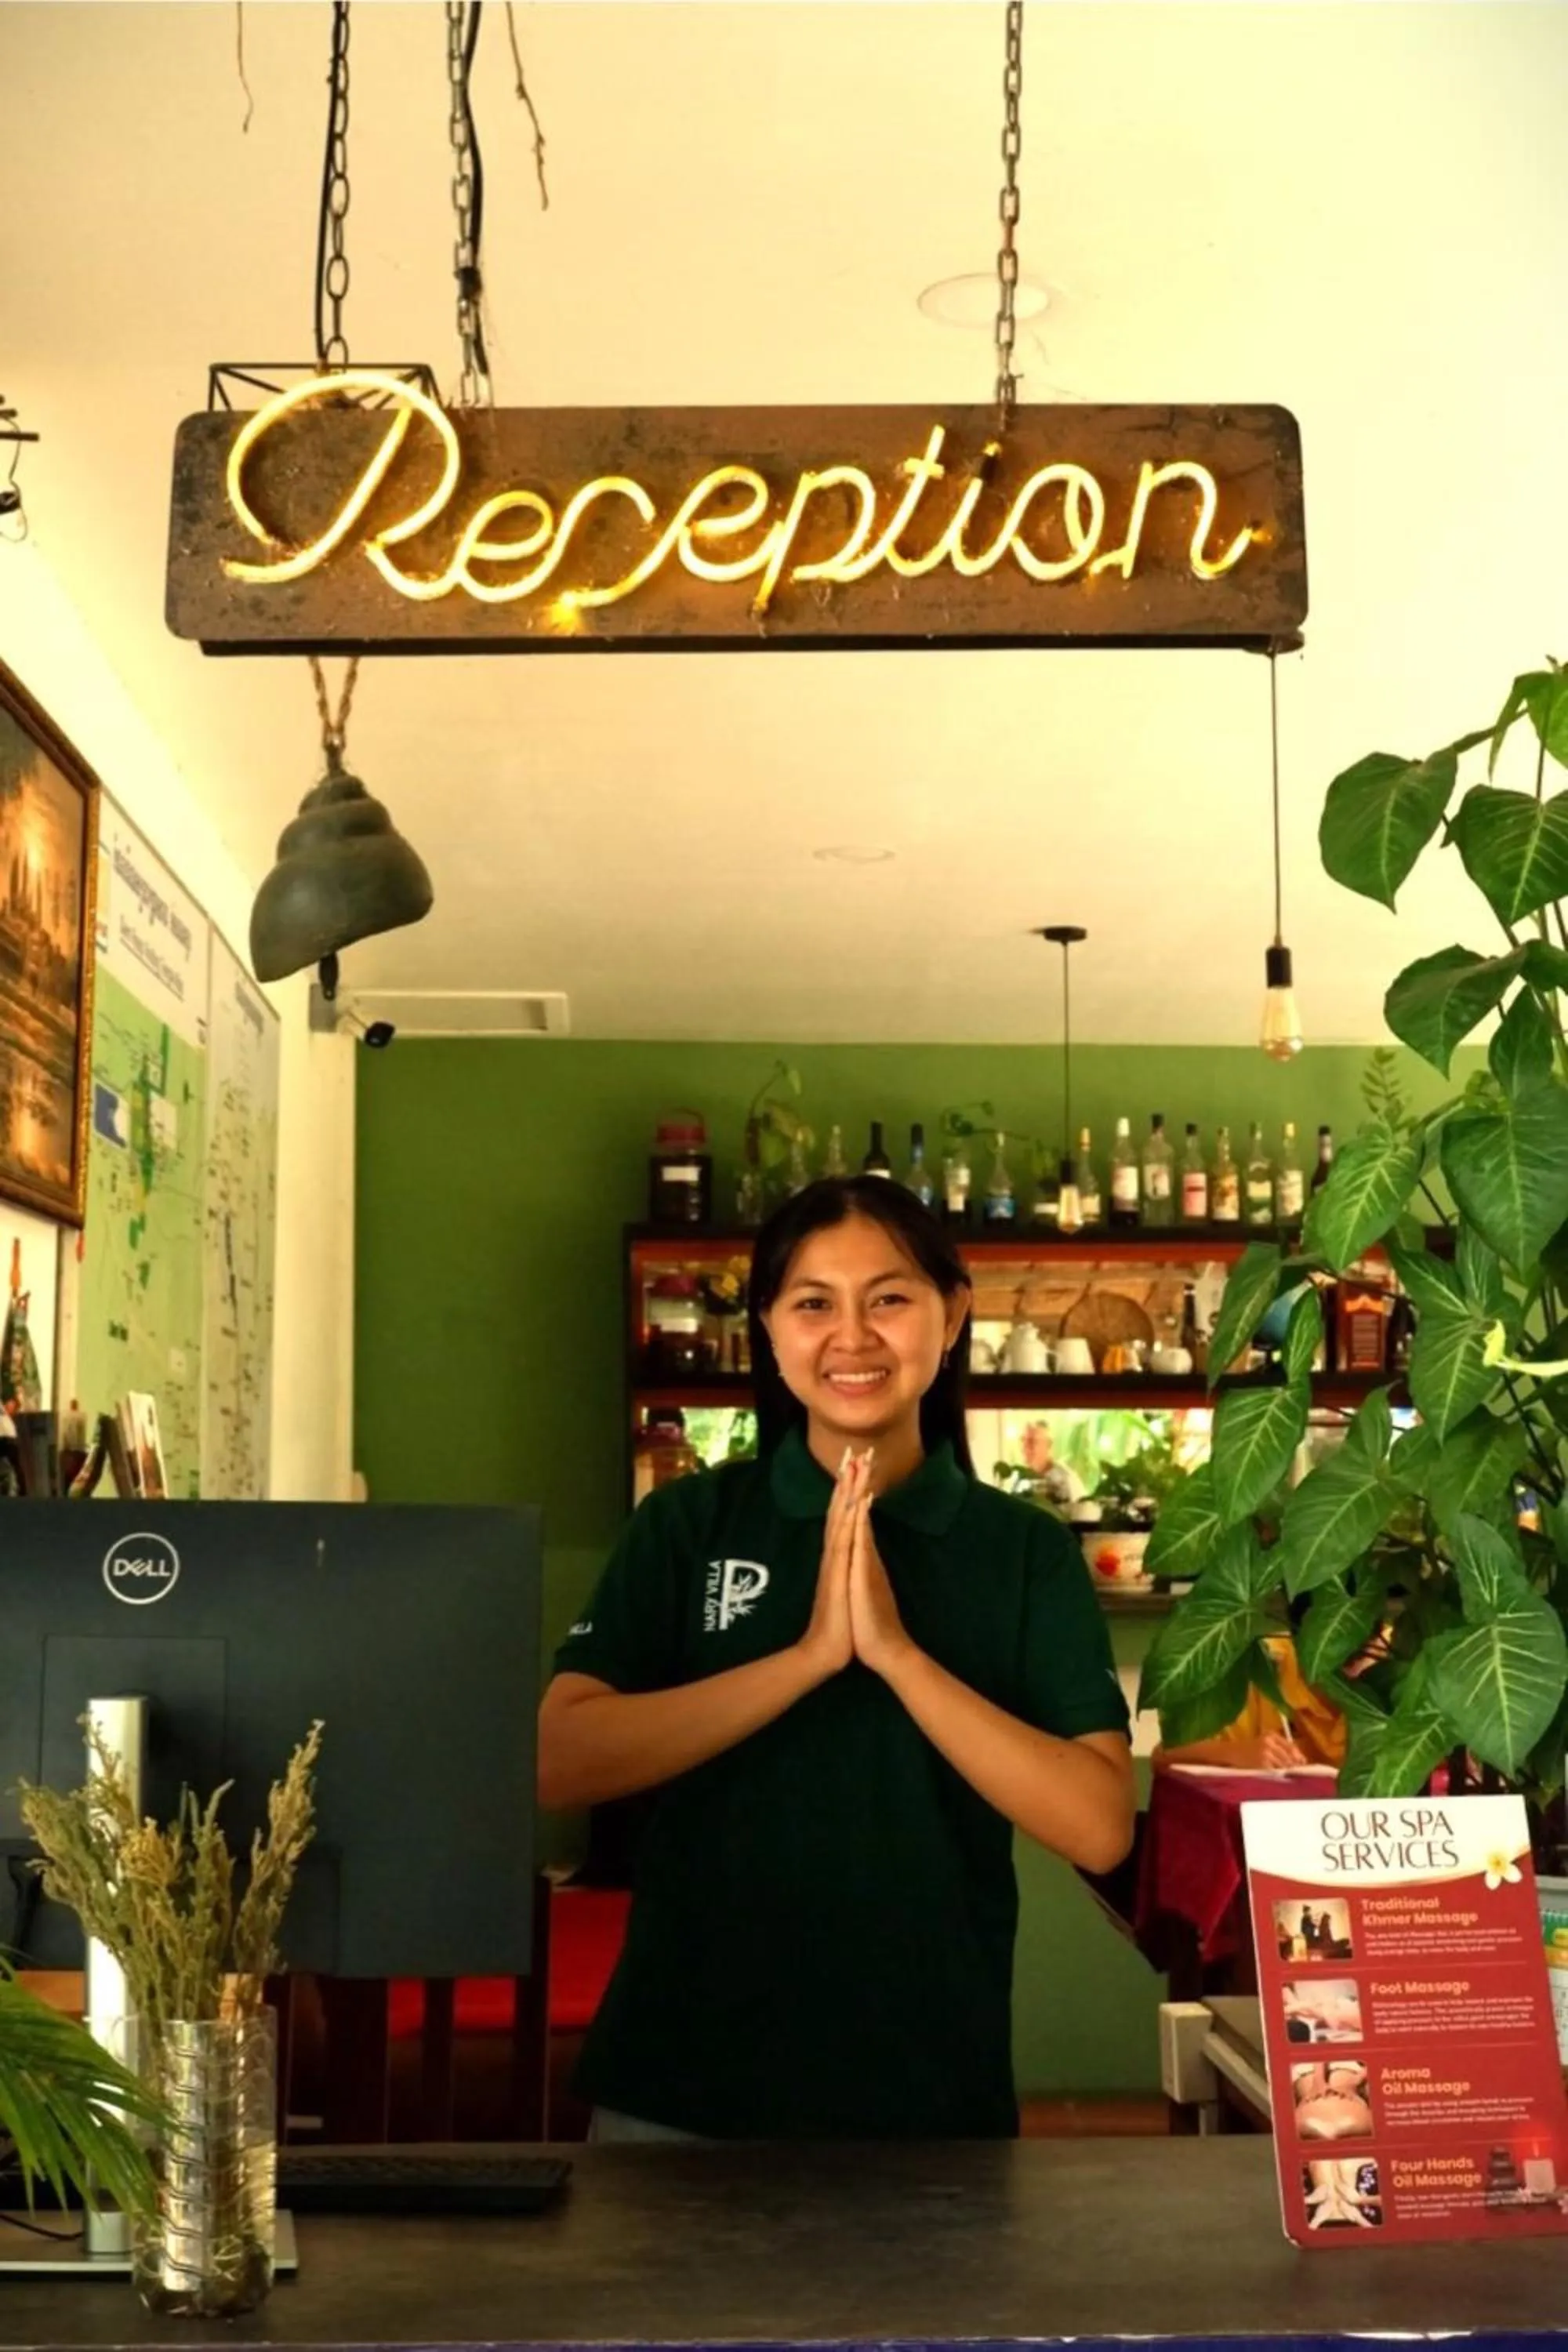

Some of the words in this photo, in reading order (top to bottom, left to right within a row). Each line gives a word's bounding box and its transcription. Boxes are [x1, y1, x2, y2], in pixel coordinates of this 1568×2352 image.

[223, 371, 1254, 618] Reception
[113, 1558, 170, 1577] DELL
[1320, 1810, 1391, 1840] OUR
[1399, 1809, 1454, 1838] SPA
[1322, 1840, 1459, 1872] SERVICES
[1361, 1896, 1439, 1911] Traditional
[1363, 1913, 1411, 1926] Khmer
[1414, 1912, 1478, 1926] Massage
[1370, 1982, 1402, 1994] Foot
[1405, 1980, 1470, 1995] Massage
[1381, 2067, 1431, 2080] Aroma
[1382, 2083, 1402, 2095] Oil
[1404, 2082, 1470, 2096] Massage
[1391, 2160, 1424, 2172] Four
[1426, 2158, 1474, 2170] Hands
[1392, 2175, 1412, 2187] Oil
[1414, 2172, 1482, 2187] Massage
